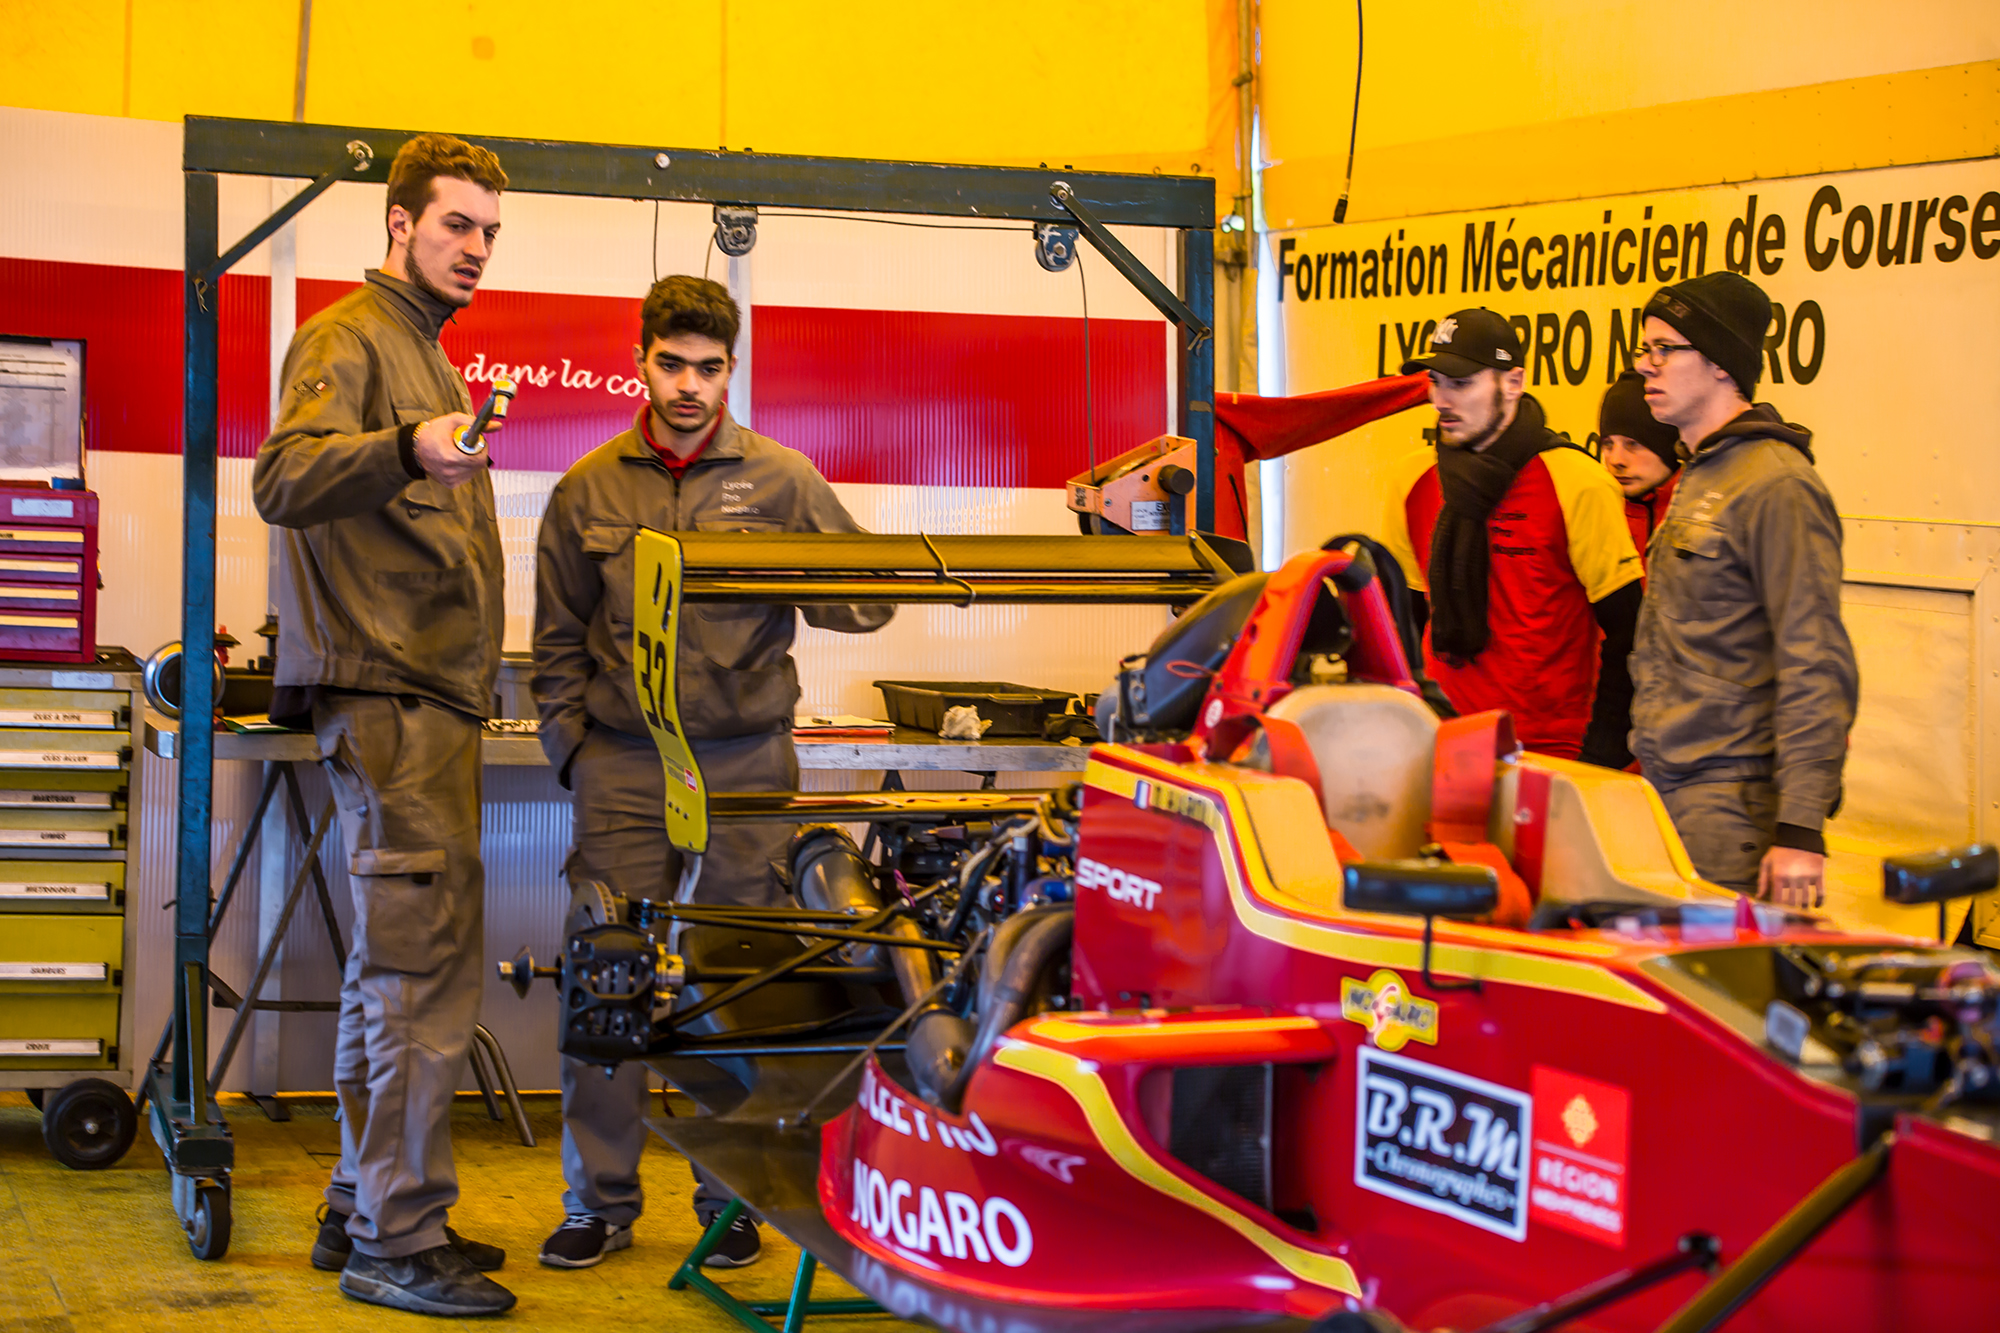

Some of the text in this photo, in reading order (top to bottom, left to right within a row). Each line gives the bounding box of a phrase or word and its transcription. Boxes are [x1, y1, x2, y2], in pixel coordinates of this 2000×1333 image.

[1278, 184, 2000, 302] Formation Mécanicien de Course
[464, 353, 556, 388] dans
[560, 358, 605, 389] la
[1076, 856, 1163, 912] SPORT
[850, 1157, 1034, 1268] NOGARO
